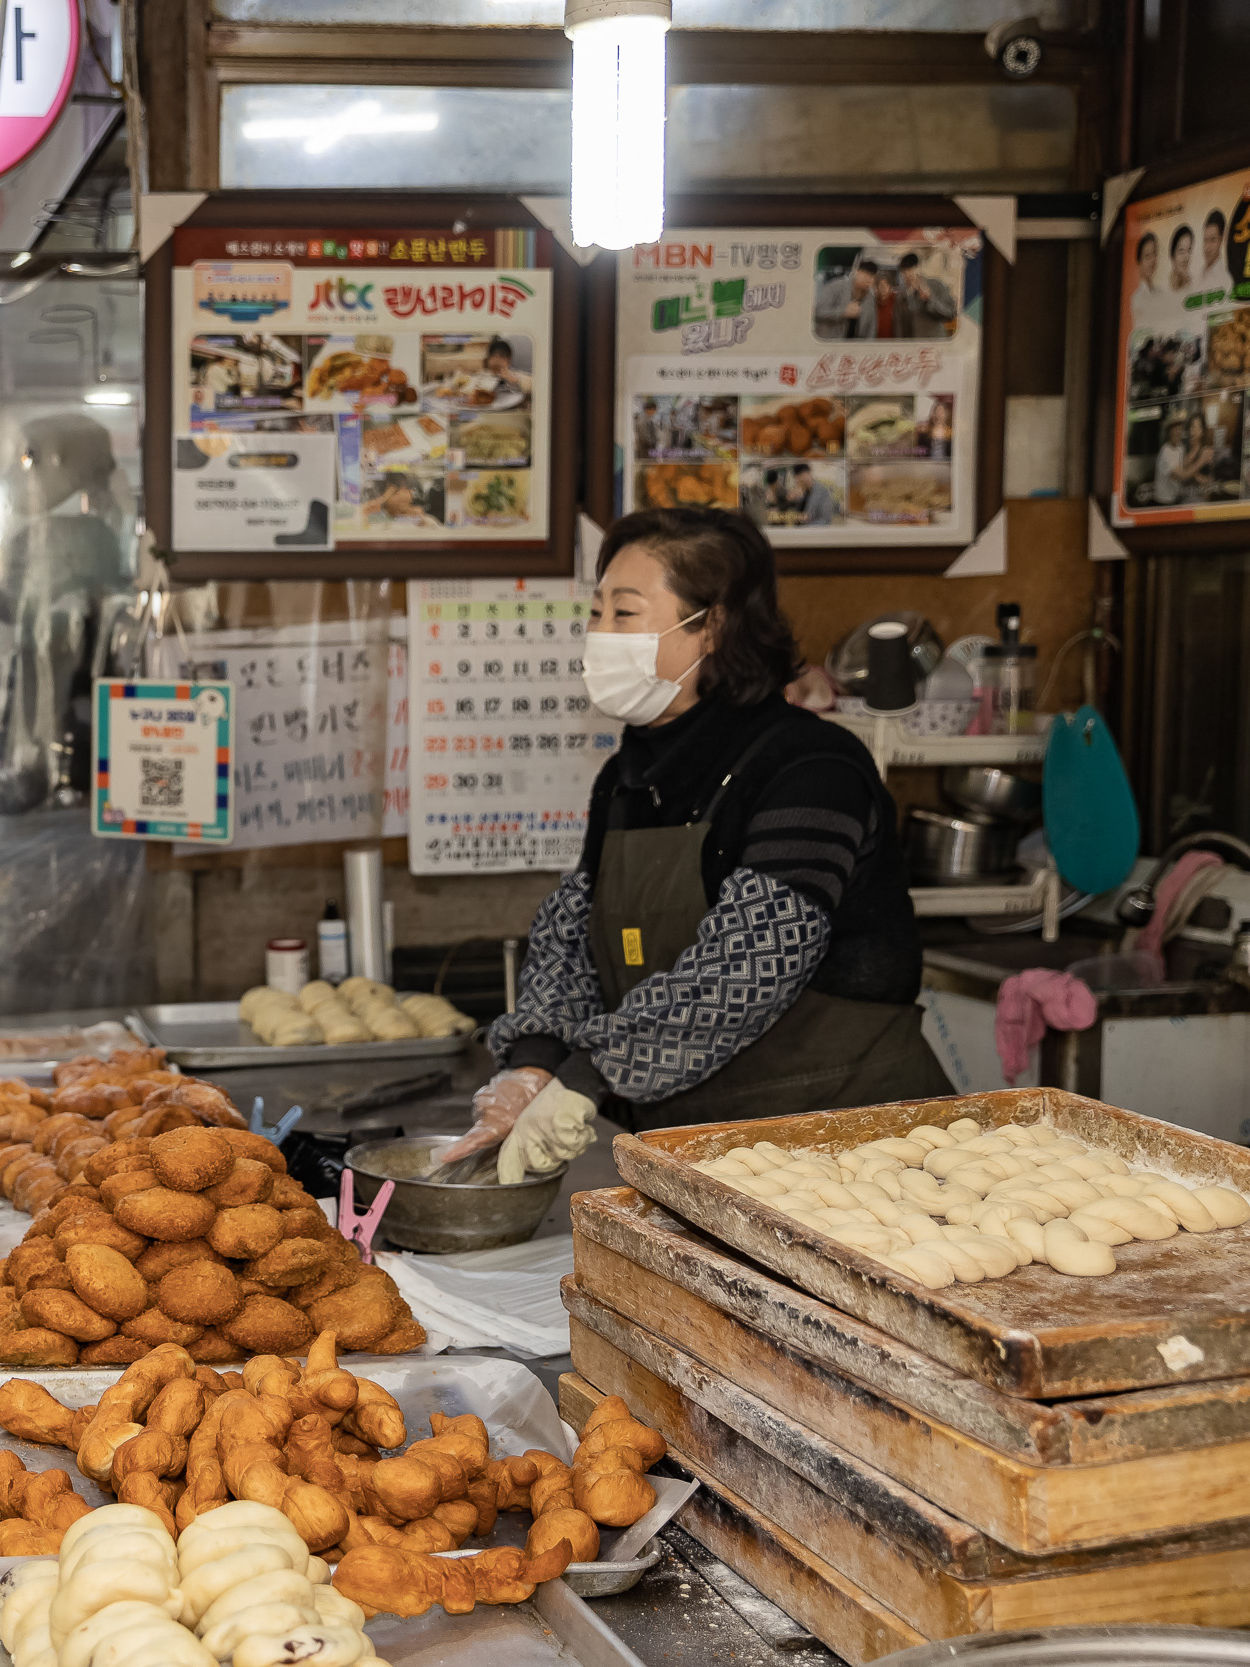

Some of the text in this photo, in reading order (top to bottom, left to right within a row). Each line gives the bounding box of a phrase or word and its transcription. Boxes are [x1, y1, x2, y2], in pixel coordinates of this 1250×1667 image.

[382, 277, 534, 319] 랜선라이프
[458, 622, 471, 638] 2
[486, 622, 499, 638] 3
[514, 622, 526, 638] 4
[542, 622, 555, 638] 5
[570, 621, 583, 637] 6
[457, 659, 471, 676] 9
[484, 659, 503, 676] 10
[513, 659, 529, 676] 11
[541, 658, 558, 675] 12
[569, 658, 585, 675] 13
[427, 696, 590, 714] 15 16 17 18 19 20
[424, 733, 616, 752] 22 23 24 25 26 27 28
[424, 773, 503, 789] 29 30 31
